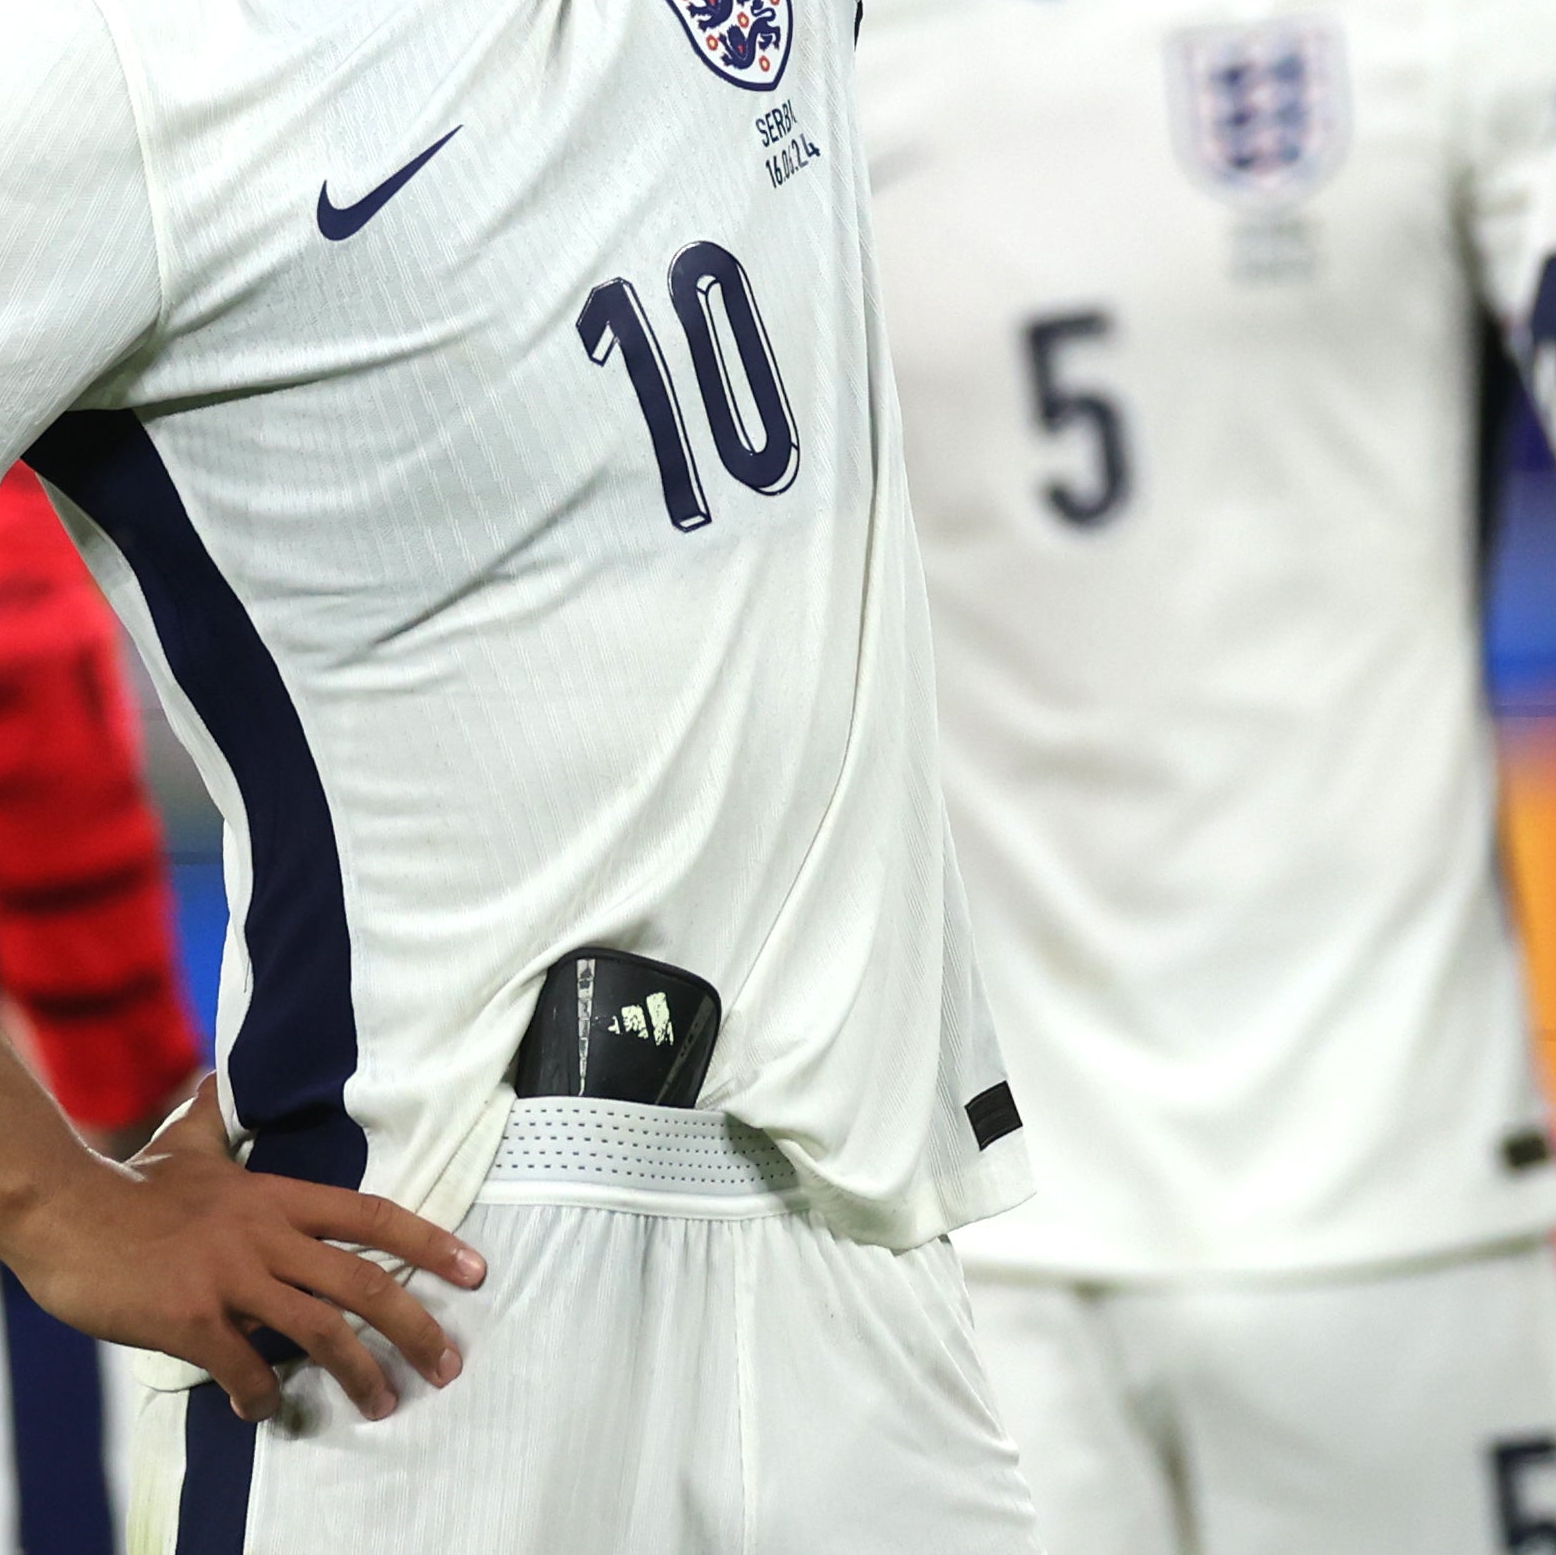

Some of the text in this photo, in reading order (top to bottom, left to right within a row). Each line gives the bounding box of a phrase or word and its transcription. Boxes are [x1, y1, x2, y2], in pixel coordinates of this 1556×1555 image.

[754, 98, 798, 148] SERBI
[576, 241, 800, 533] 10
[1019, 306, 1135, 531] 5
